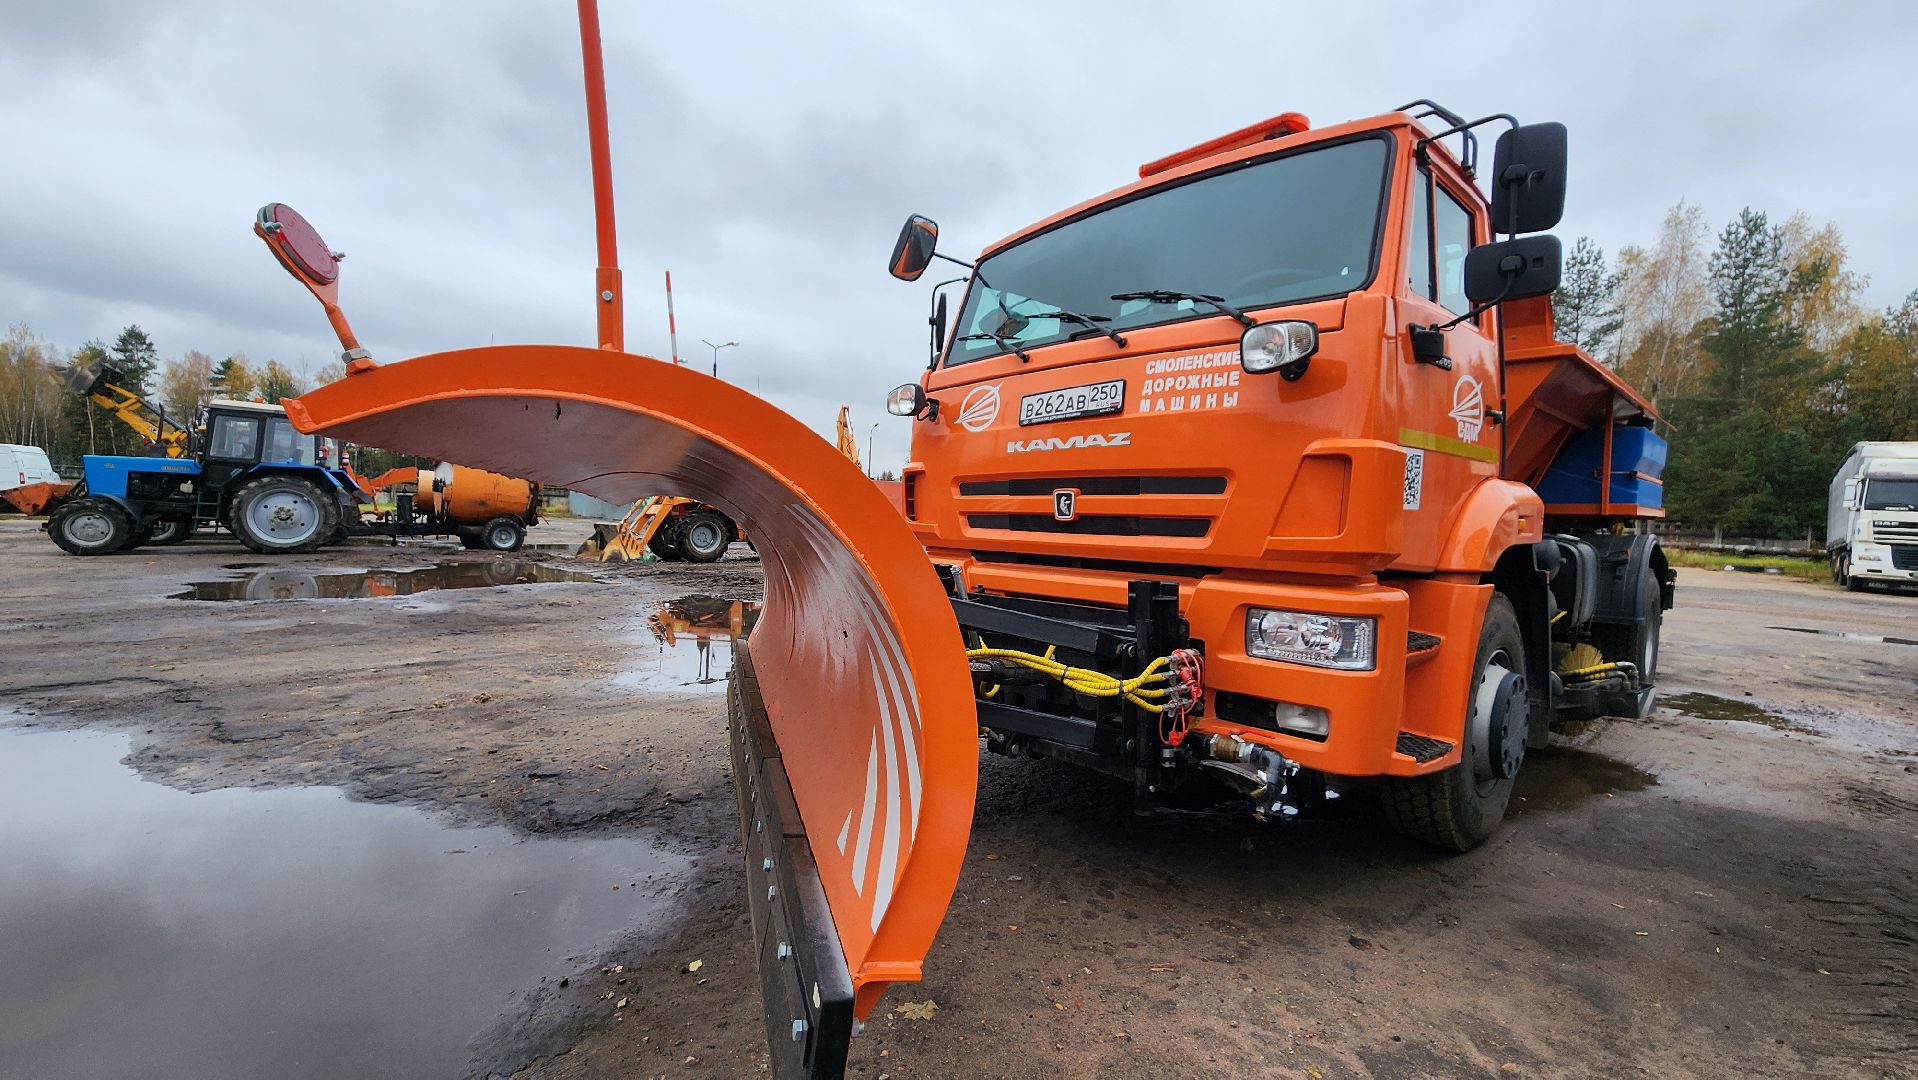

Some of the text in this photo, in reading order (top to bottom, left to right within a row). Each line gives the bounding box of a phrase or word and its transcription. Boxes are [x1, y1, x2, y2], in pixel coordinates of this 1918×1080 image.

[1145, 351, 1240, 375] СМОЛЕНСКИЕ
[1090, 384, 1118, 402] 250
[1142, 371, 1240, 396] ДОРОЖНЫЕ
[1139, 392, 1239, 413] МАШИНЫ
[1007, 432, 1131, 452] KAMAZ
